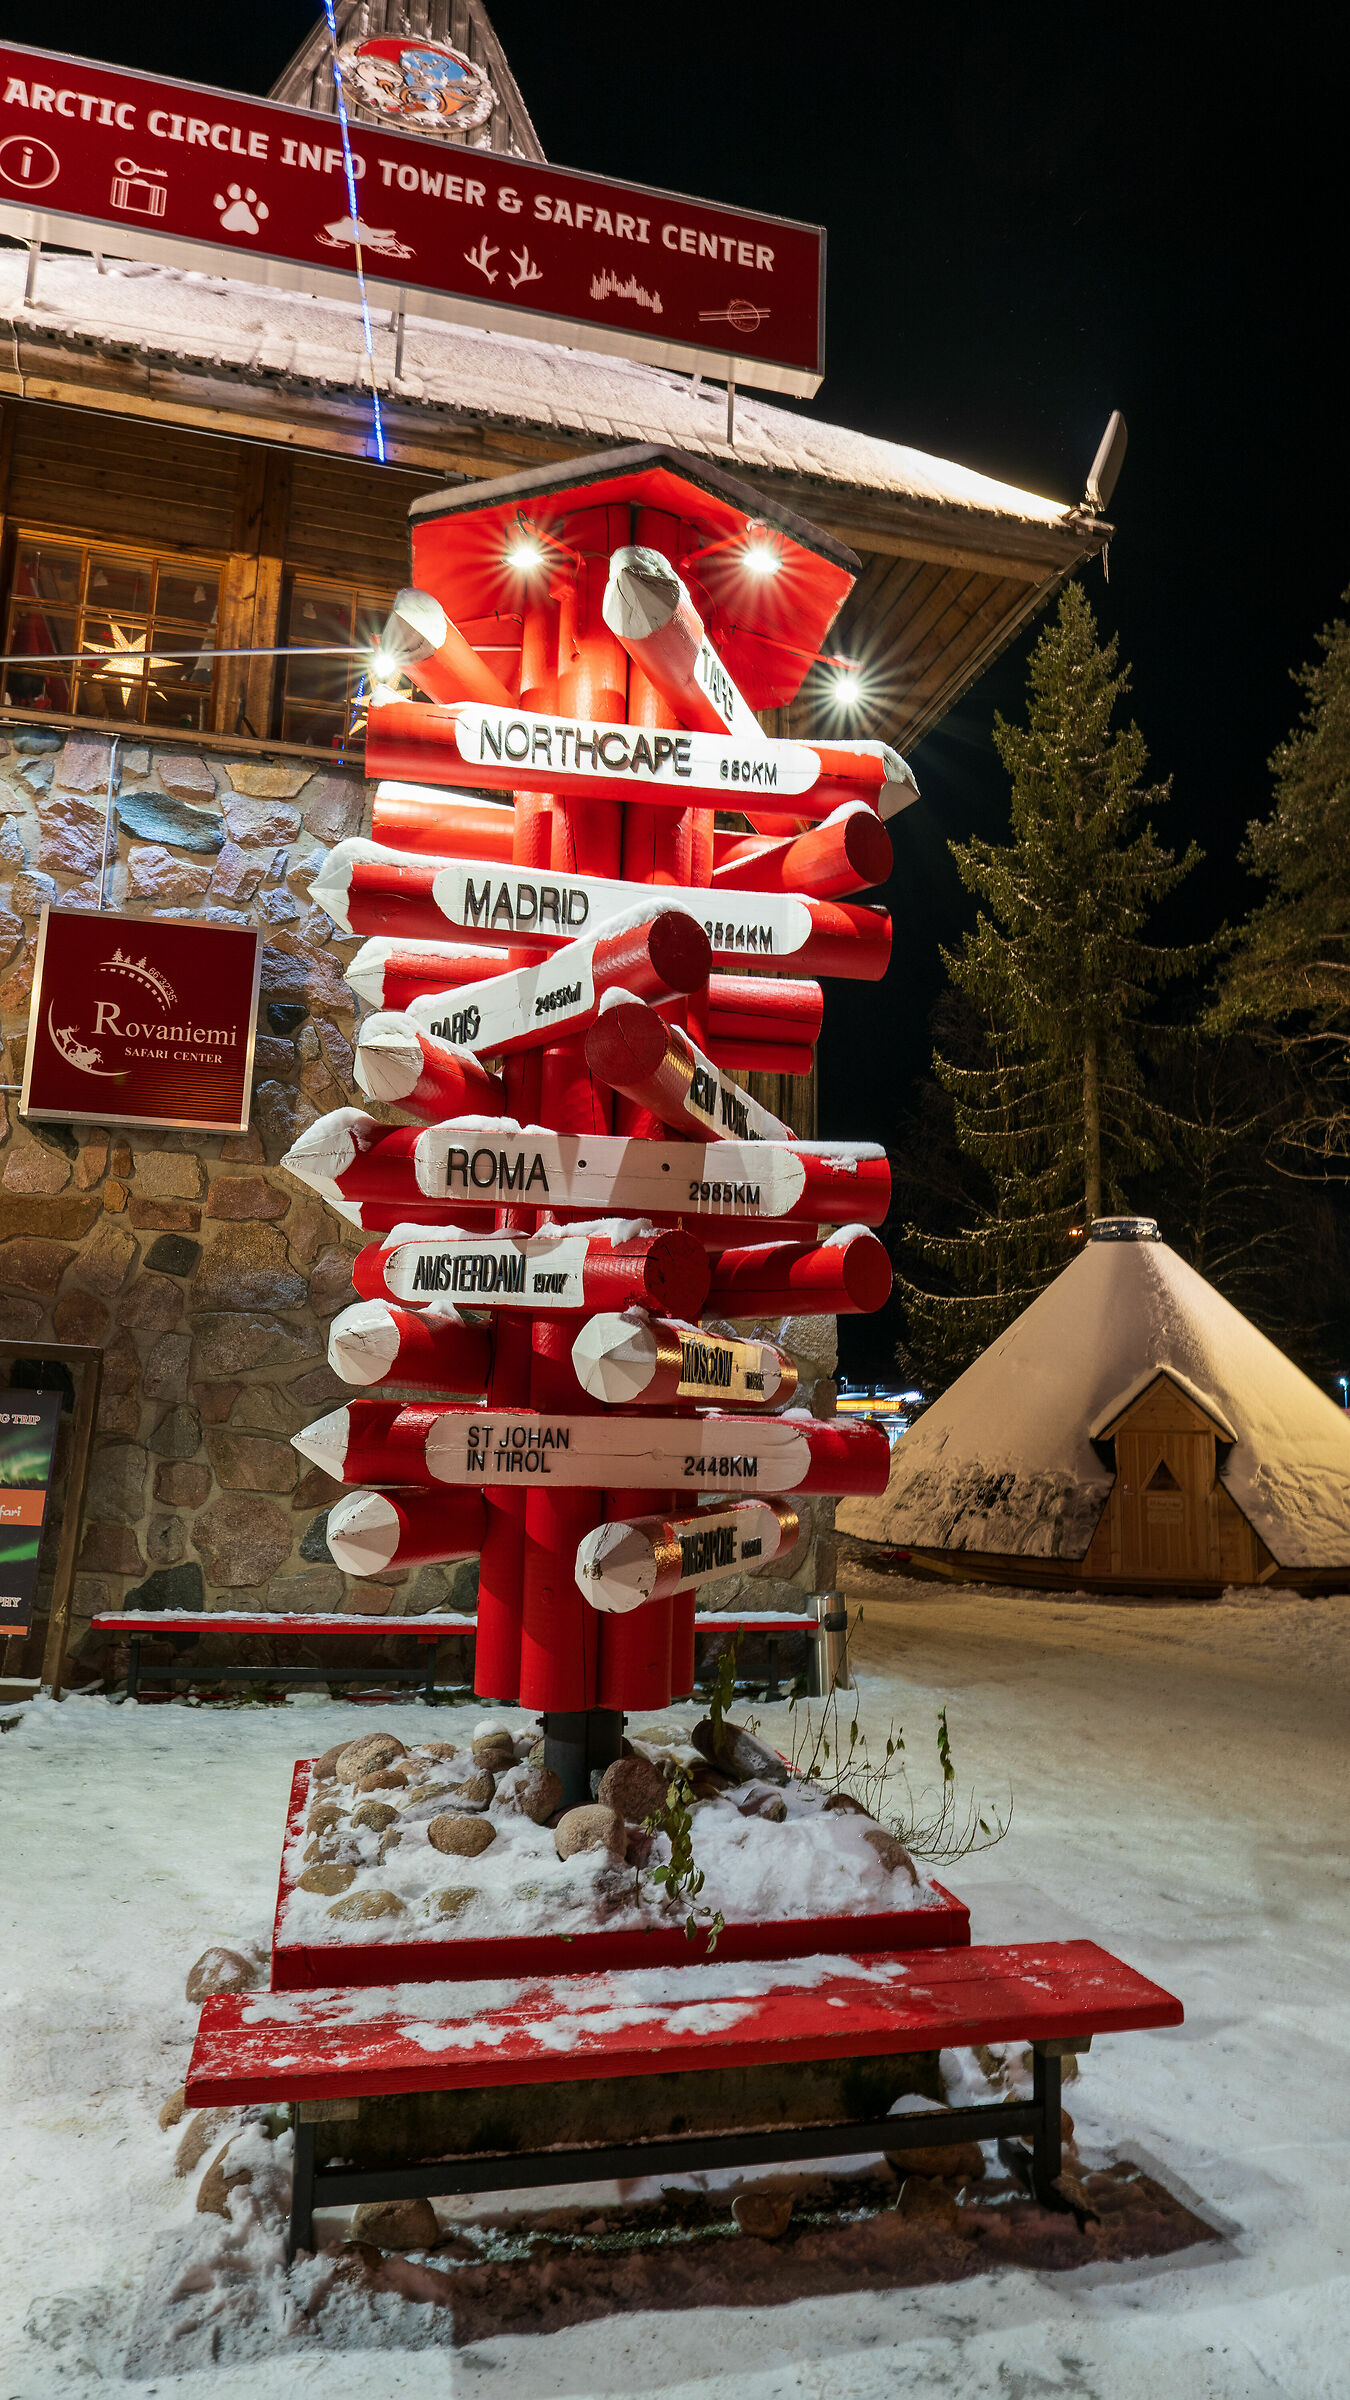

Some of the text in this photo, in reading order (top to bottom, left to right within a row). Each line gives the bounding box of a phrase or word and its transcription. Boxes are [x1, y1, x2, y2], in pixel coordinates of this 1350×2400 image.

[5, 77, 775, 272] ARCTIC CIRCLE INFO TOWER & SAFARI CENTER
[480, 719, 692, 777] NORTHCAPE
[463, 878, 589, 926] MADRID
[90, 1000, 237, 1046] Rovaniemi
[430, 1004, 481, 1045] PARIS
[124, 1047, 223, 1064] SAFARI CENTER
[720, 1086, 749, 1140] YORK
[446, 1146, 760, 1204] ROMA 2985KM
[412, 1253, 527, 1293] AMSTERDAM
[680, 1341, 734, 1387] MOSCOW
[11, 1414, 41, 1425] TRIP
[467, 1426, 570, 1449] ST JOHAN
[467, 1450, 551, 1474] IN TIROL
[683, 1455, 759, 1478] 2448KM
[680, 1526, 738, 1579] SINGAPORE
